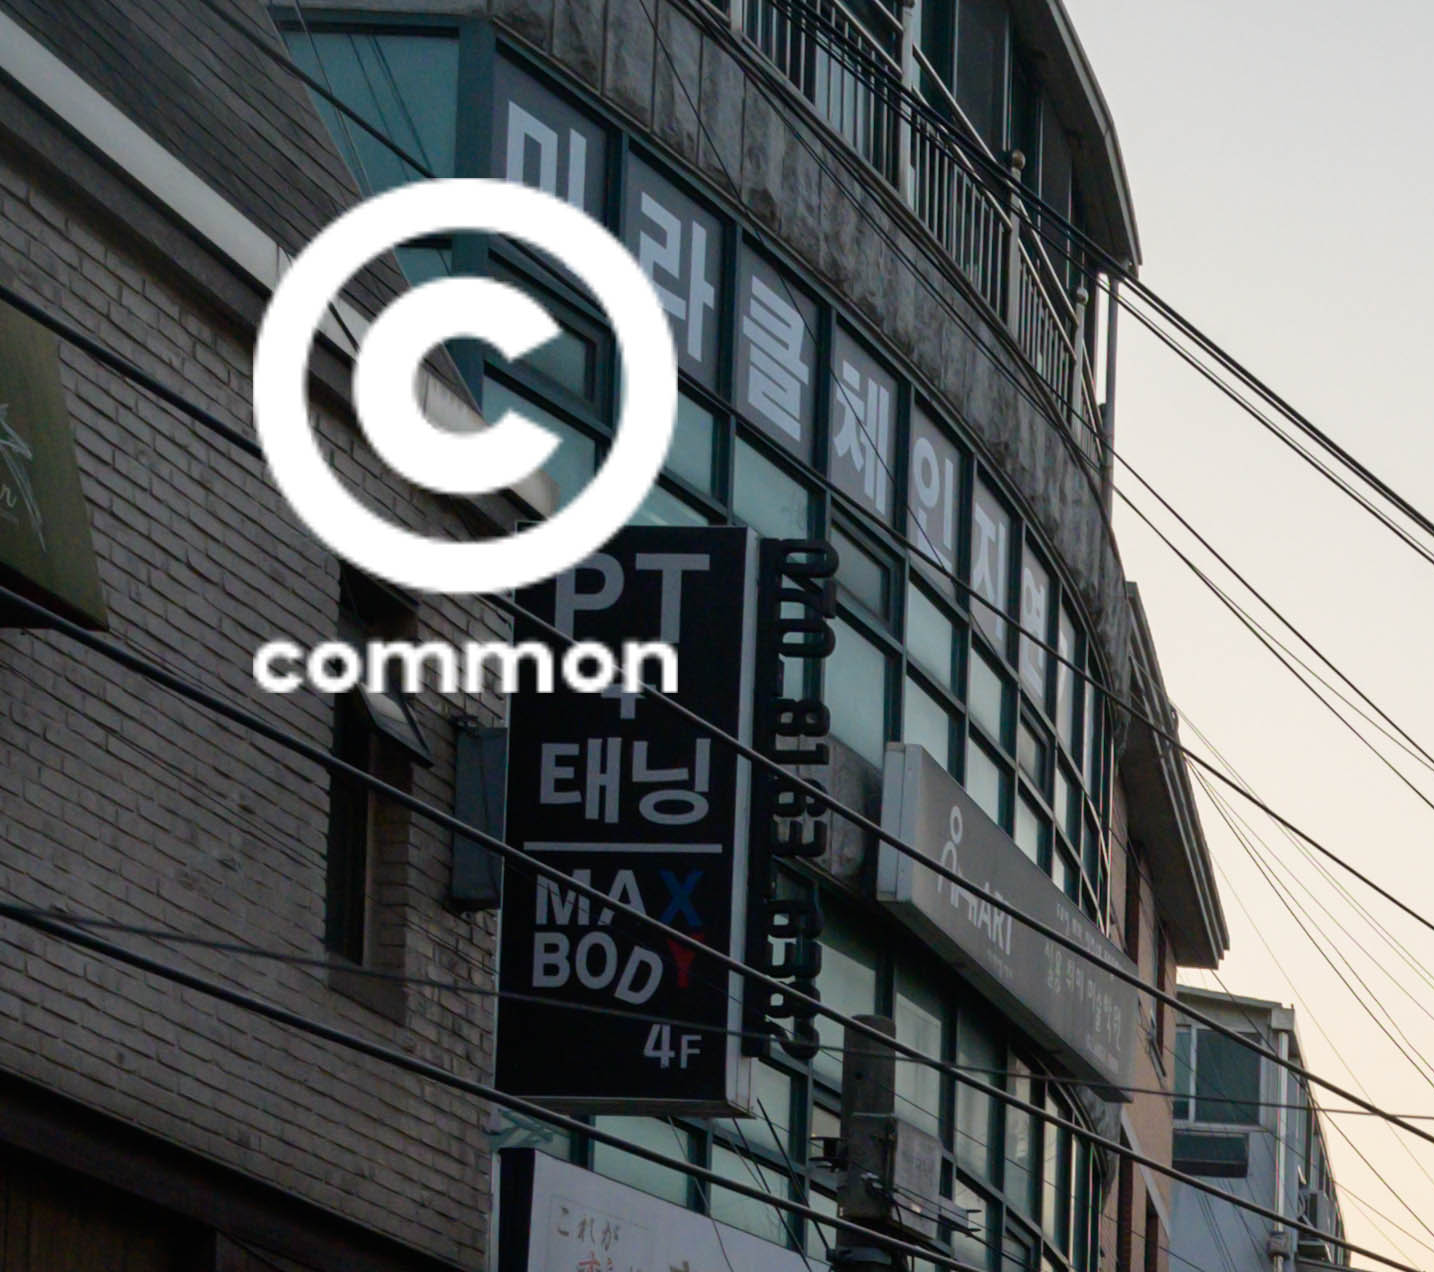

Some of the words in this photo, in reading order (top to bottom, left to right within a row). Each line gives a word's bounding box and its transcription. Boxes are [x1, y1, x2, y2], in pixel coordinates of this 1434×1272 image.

[540, 738, 710, 826] 태닝
[535, 869, 704, 927] MAX
[532, 931, 697, 1006] BODY
[643, 1023, 703, 1069] 4F
